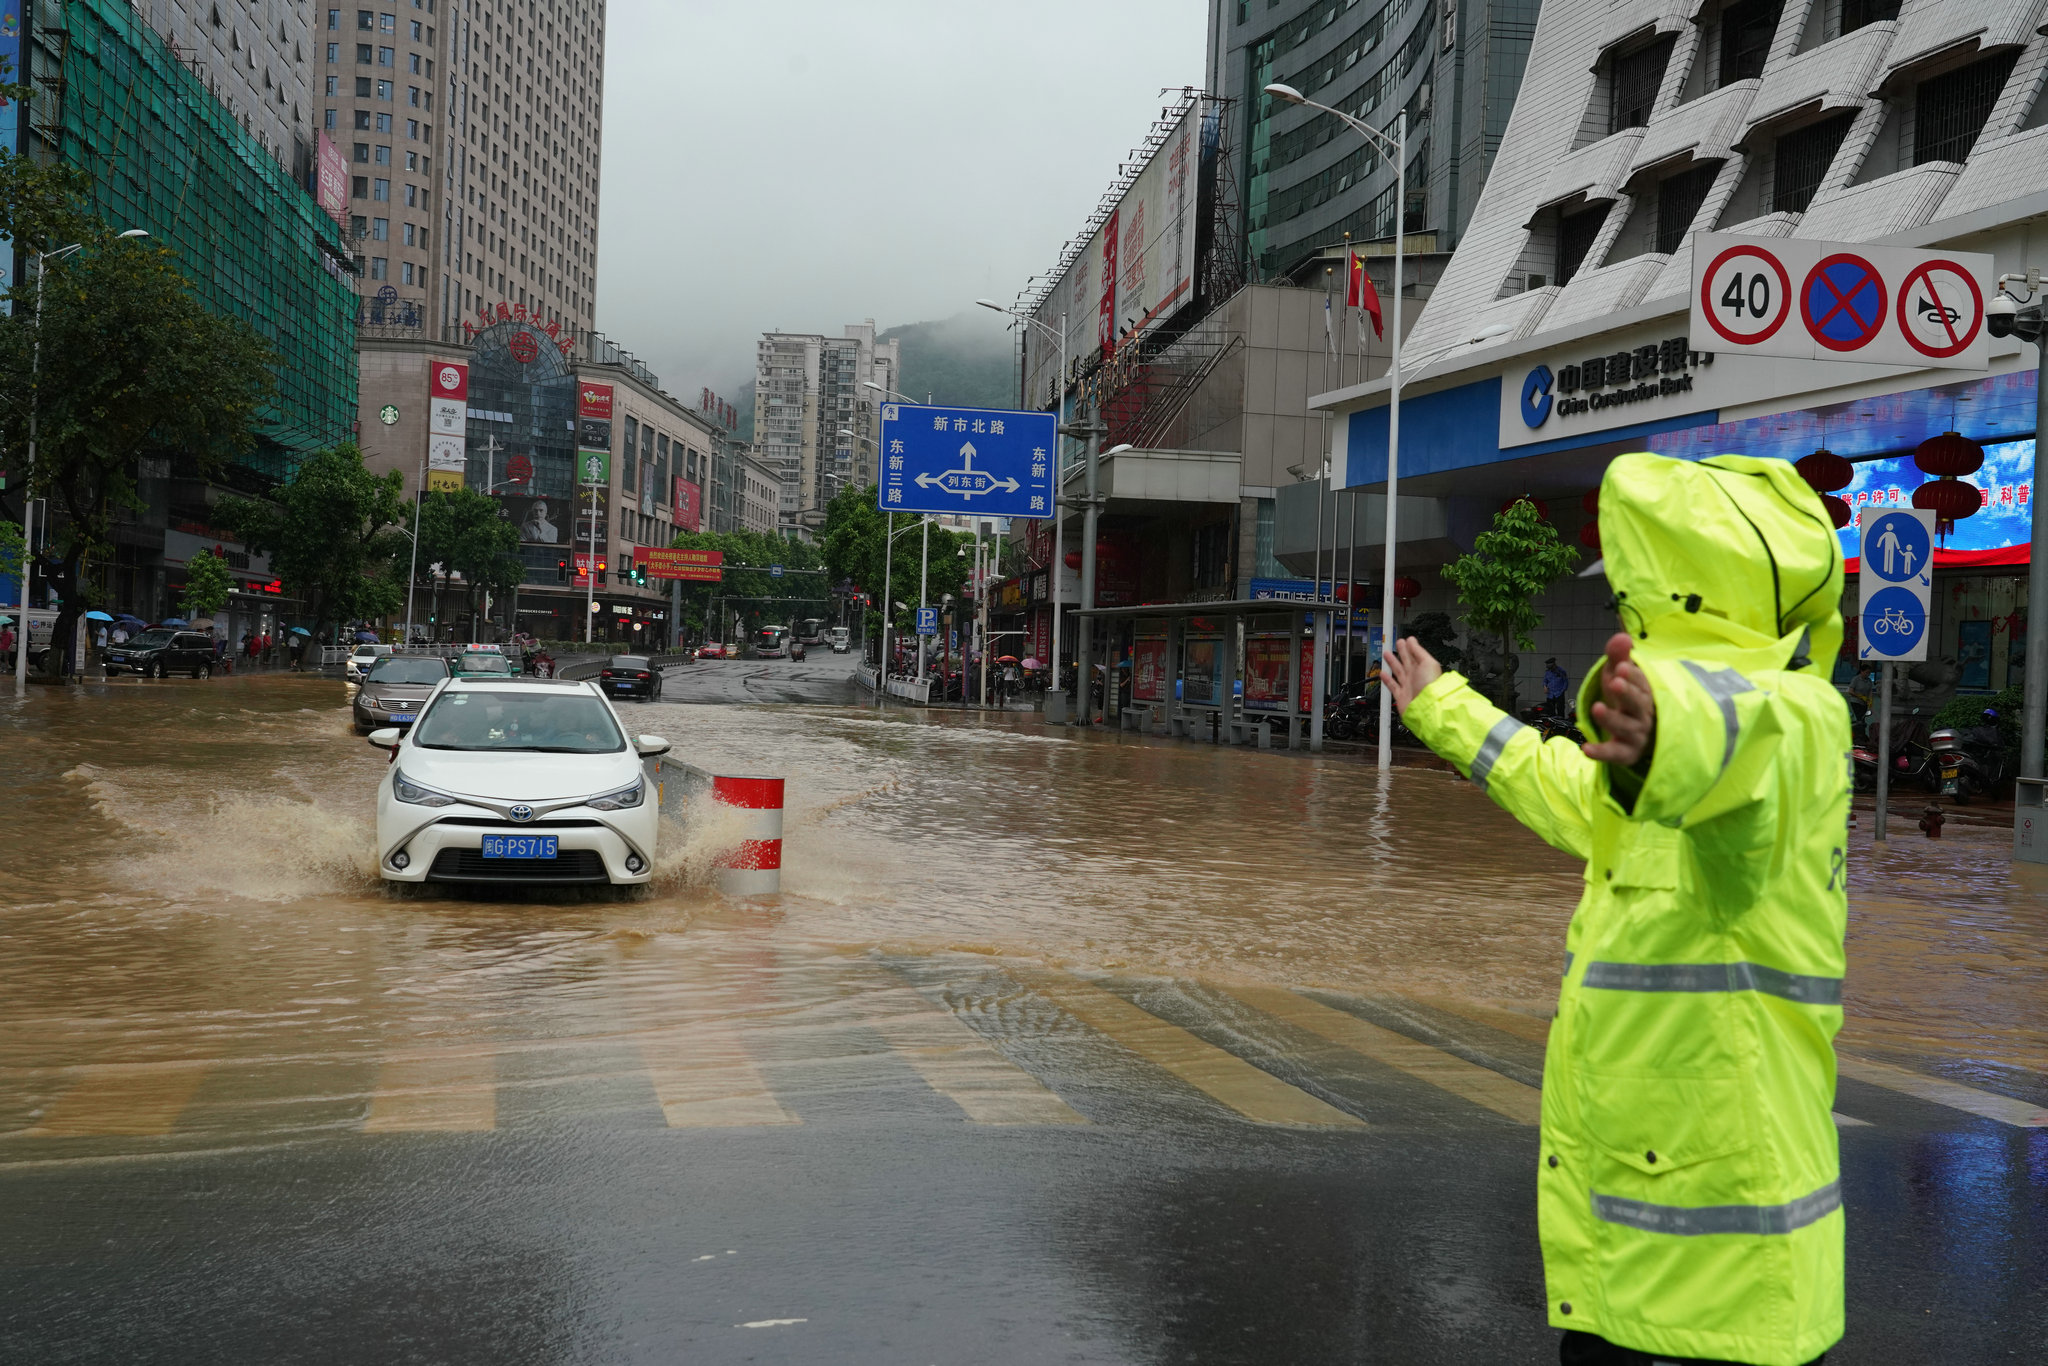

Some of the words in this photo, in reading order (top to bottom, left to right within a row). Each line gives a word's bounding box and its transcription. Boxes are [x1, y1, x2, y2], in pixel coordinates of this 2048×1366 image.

[1722, 271, 1769, 319] 40
[462, 302, 576, 355] 天元国际大酒店
[1557, 397, 1588, 417] China
[1590, 381, 1658, 410] Construction
[1660, 373, 1693, 396] Bank
[934, 416, 1004, 435] 新市北路
[887, 439, 904, 504] 东新三路
[1030, 447, 1046, 510] 东新一路
[948, 475, 986, 489] 列东街
[1833, 488, 1906, 508] 账户许可,
[578, 567, 587, 576] 70
[631, 570, 637, 579] 9
[919, 610, 934, 627] P
